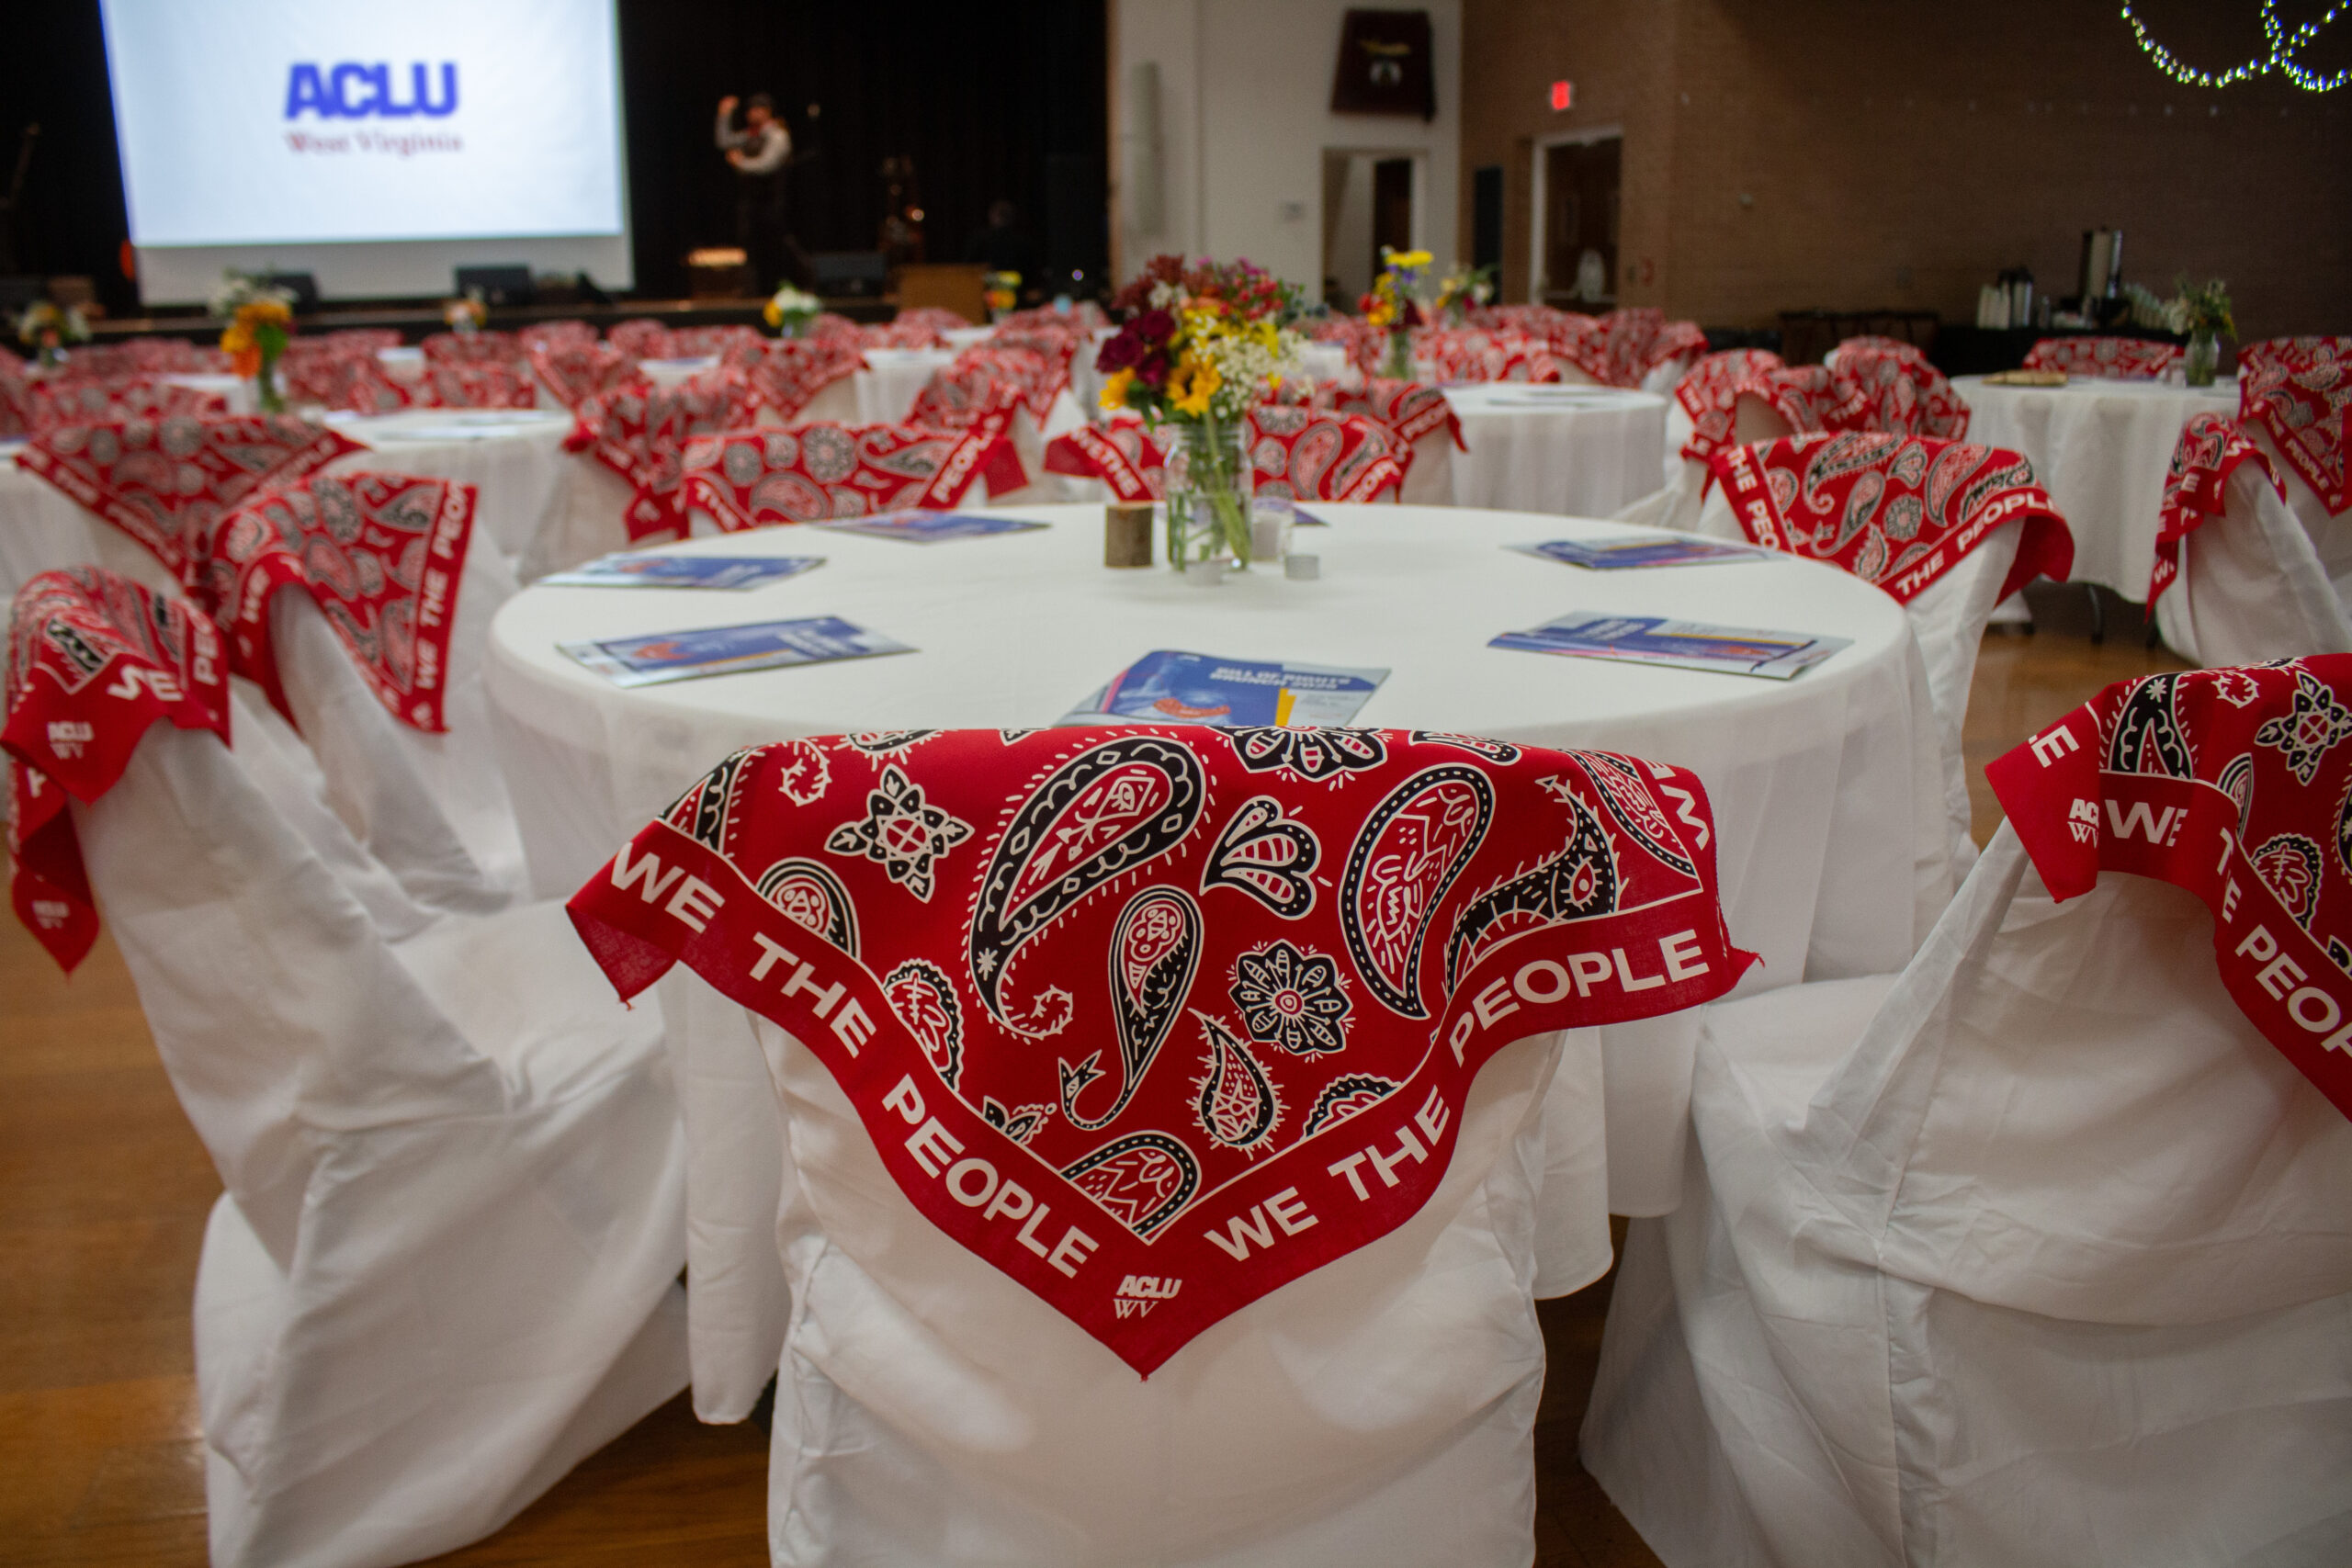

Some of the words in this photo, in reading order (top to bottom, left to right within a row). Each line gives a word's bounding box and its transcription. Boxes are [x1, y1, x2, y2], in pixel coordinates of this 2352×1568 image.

[285, 61, 460, 118] ACLU
[1746, 498, 1781, 551] PEO
[1895, 549, 1945, 596] THE
[1956, 492, 2055, 553] PEOPL
[418, 566, 448, 627] THE
[106, 664, 184, 702] WE
[2104, 798, 2189, 848] WE
[2216, 827, 2243, 925] TE
[609, 841, 725, 933] WE
[748, 931, 877, 1059] THE
[881, 1073, 1100, 1279] PEOPLE
[1204, 1187, 1319, 1262] WE
[1328, 1085, 1452, 1201] THE
[1448, 929, 1710, 1067] PEOPLE
[1113, 1298, 1159, 1319] WV
[1115, 1274, 1182, 1299] ACLU
